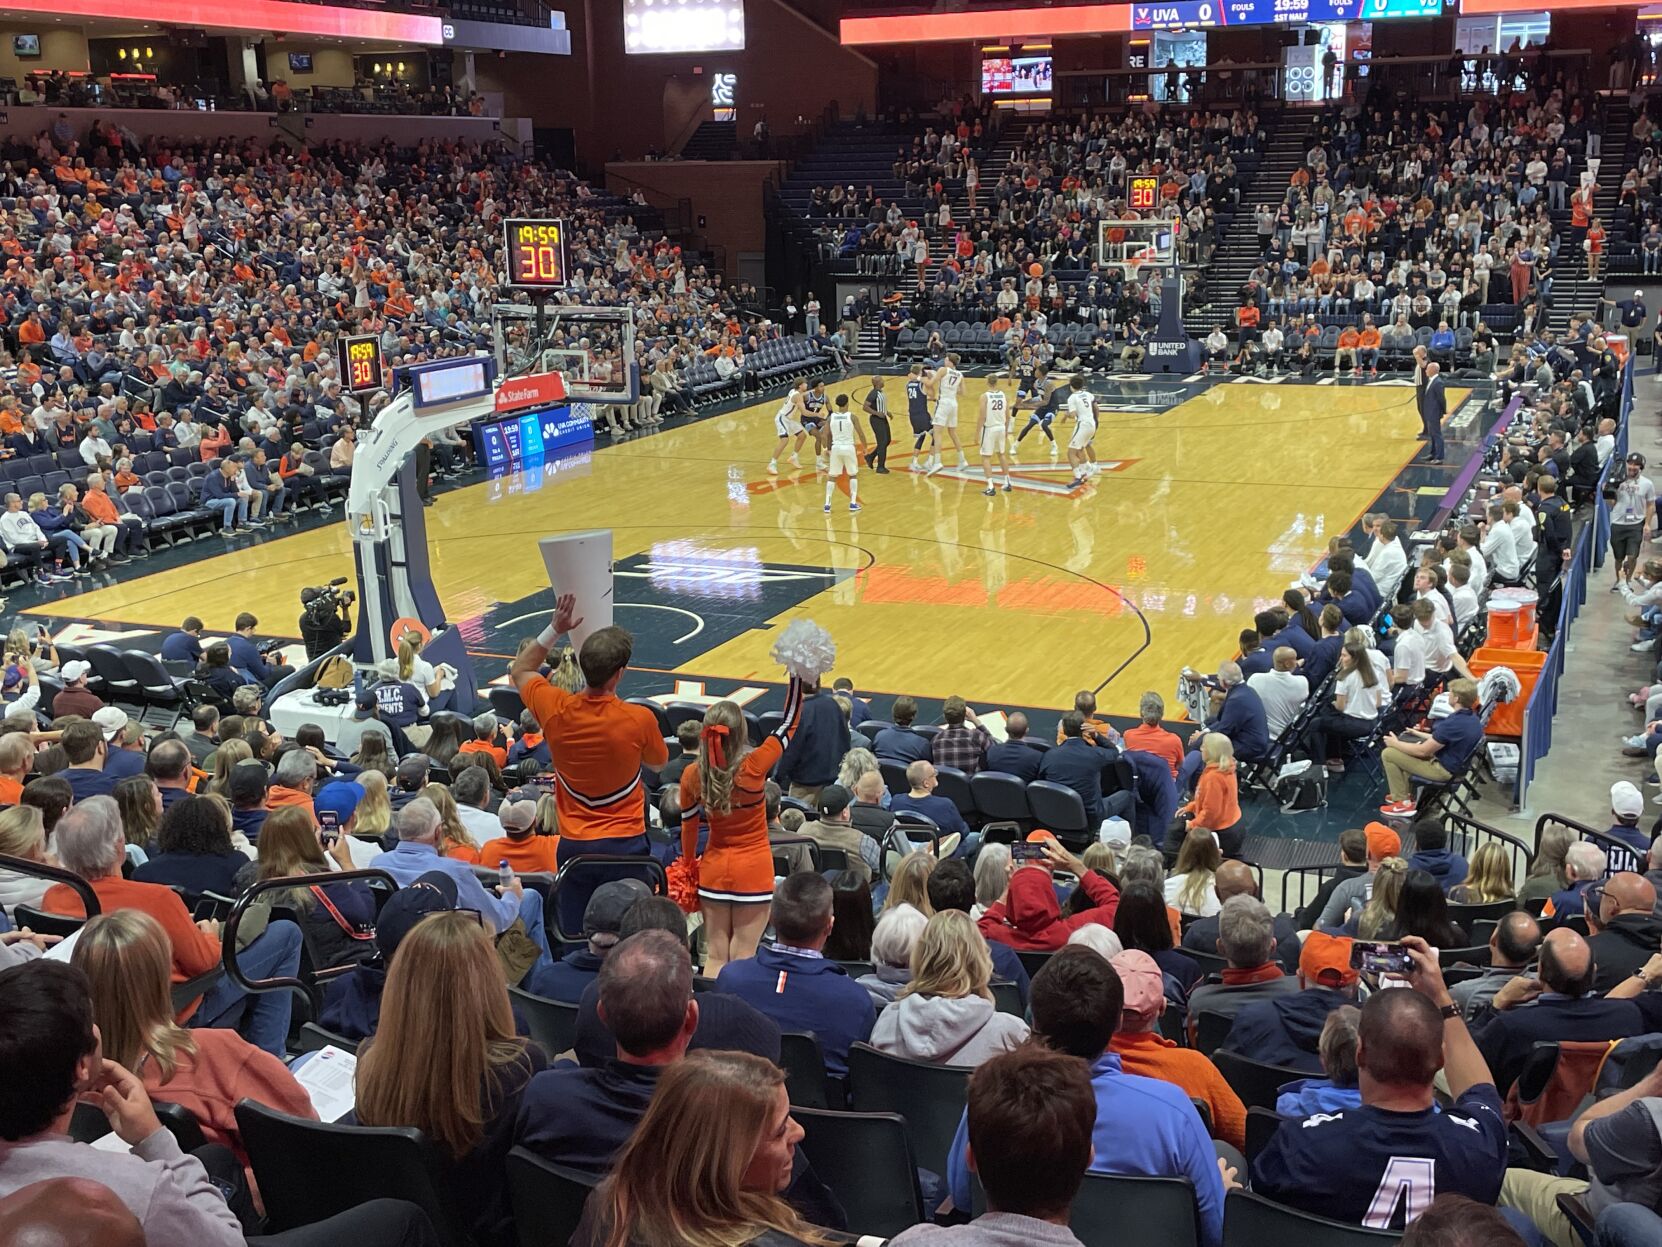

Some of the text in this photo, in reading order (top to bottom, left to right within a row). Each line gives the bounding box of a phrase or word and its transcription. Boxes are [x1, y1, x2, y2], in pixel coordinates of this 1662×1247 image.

[1231, 3, 1255, 12] FOULS
[1274, 0, 1309, 11] 19:59
[1337, 6, 1344, 15] 0
[1153, 9, 1179, 21] UVA
[1199, 4, 1212, 20] 0
[1239, 12, 1246, 20] 0
[1274, 12, 1308, 22] 1ST HALF
[1133, 179, 1156, 188] 19:59
[1134, 189, 1152, 206] 30
[519, 225, 558, 244] 19:59
[521, 246, 554, 278] 30
[1158, 342, 1186, 350] UNITED
[354, 361, 371, 383] 30
[949, 376, 958, 386] 17
[908, 388, 917, 399] 24
[991, 399, 1003, 411] 28
[1082, 398, 1090, 408] 5
[839, 421, 843, 432] 1
[491, 435, 497, 445] 0
[378, 701, 403, 713] VENTS
